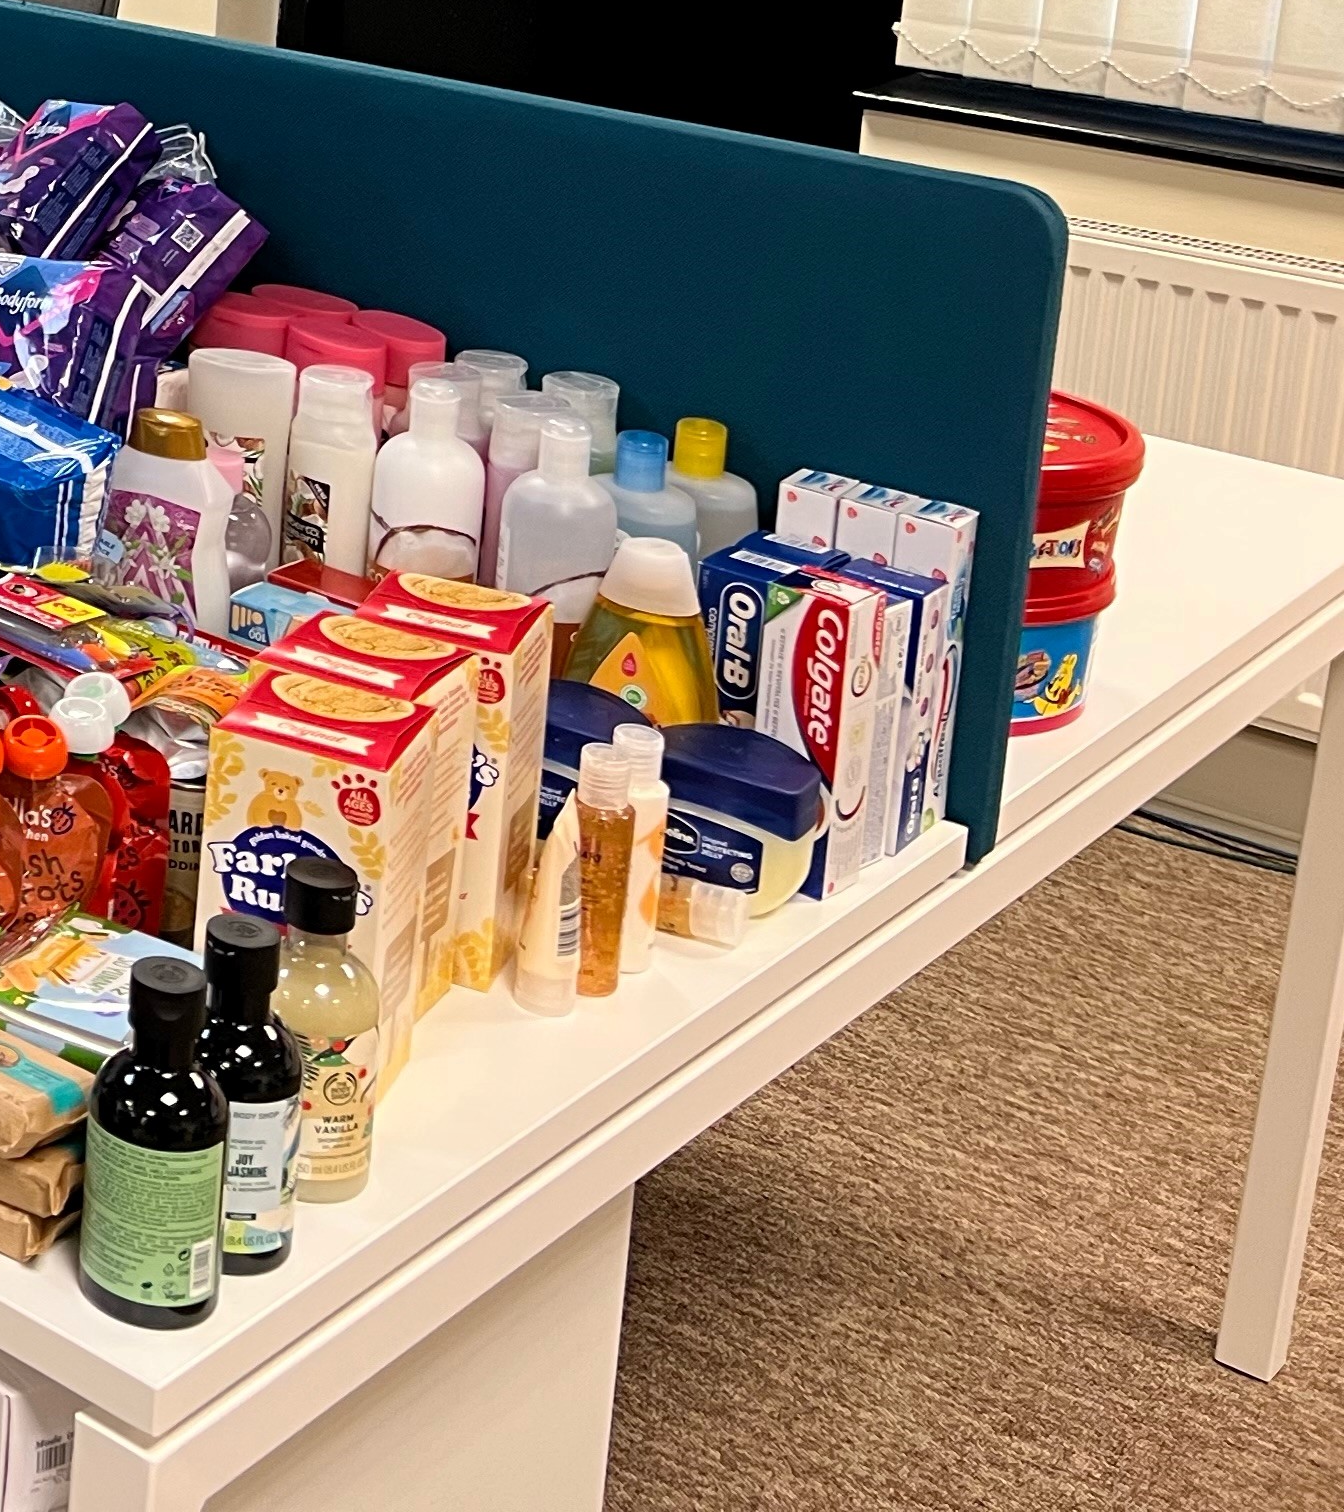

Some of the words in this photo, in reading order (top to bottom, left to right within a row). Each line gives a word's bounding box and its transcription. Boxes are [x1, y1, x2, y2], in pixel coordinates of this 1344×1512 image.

[405, 611, 473, 630] Original
[720, 591, 758, 688] Oral-B
[312, 654, 380, 677] Original
[806, 607, 845, 750] Colgate
[277, 720, 348, 744] Original
[348, 790, 368, 803] ALL
[343, 799, 374, 815] AGES
[275, 829, 302, 844] baked
[700, 849, 724, 861] JELLY
[701, 842, 754, 861] PROTECTING
[321, 1114, 355, 1125] WARM
[314, 1122, 359, 1135] VANILLA
[235, 1153, 254, 1167] JOY
